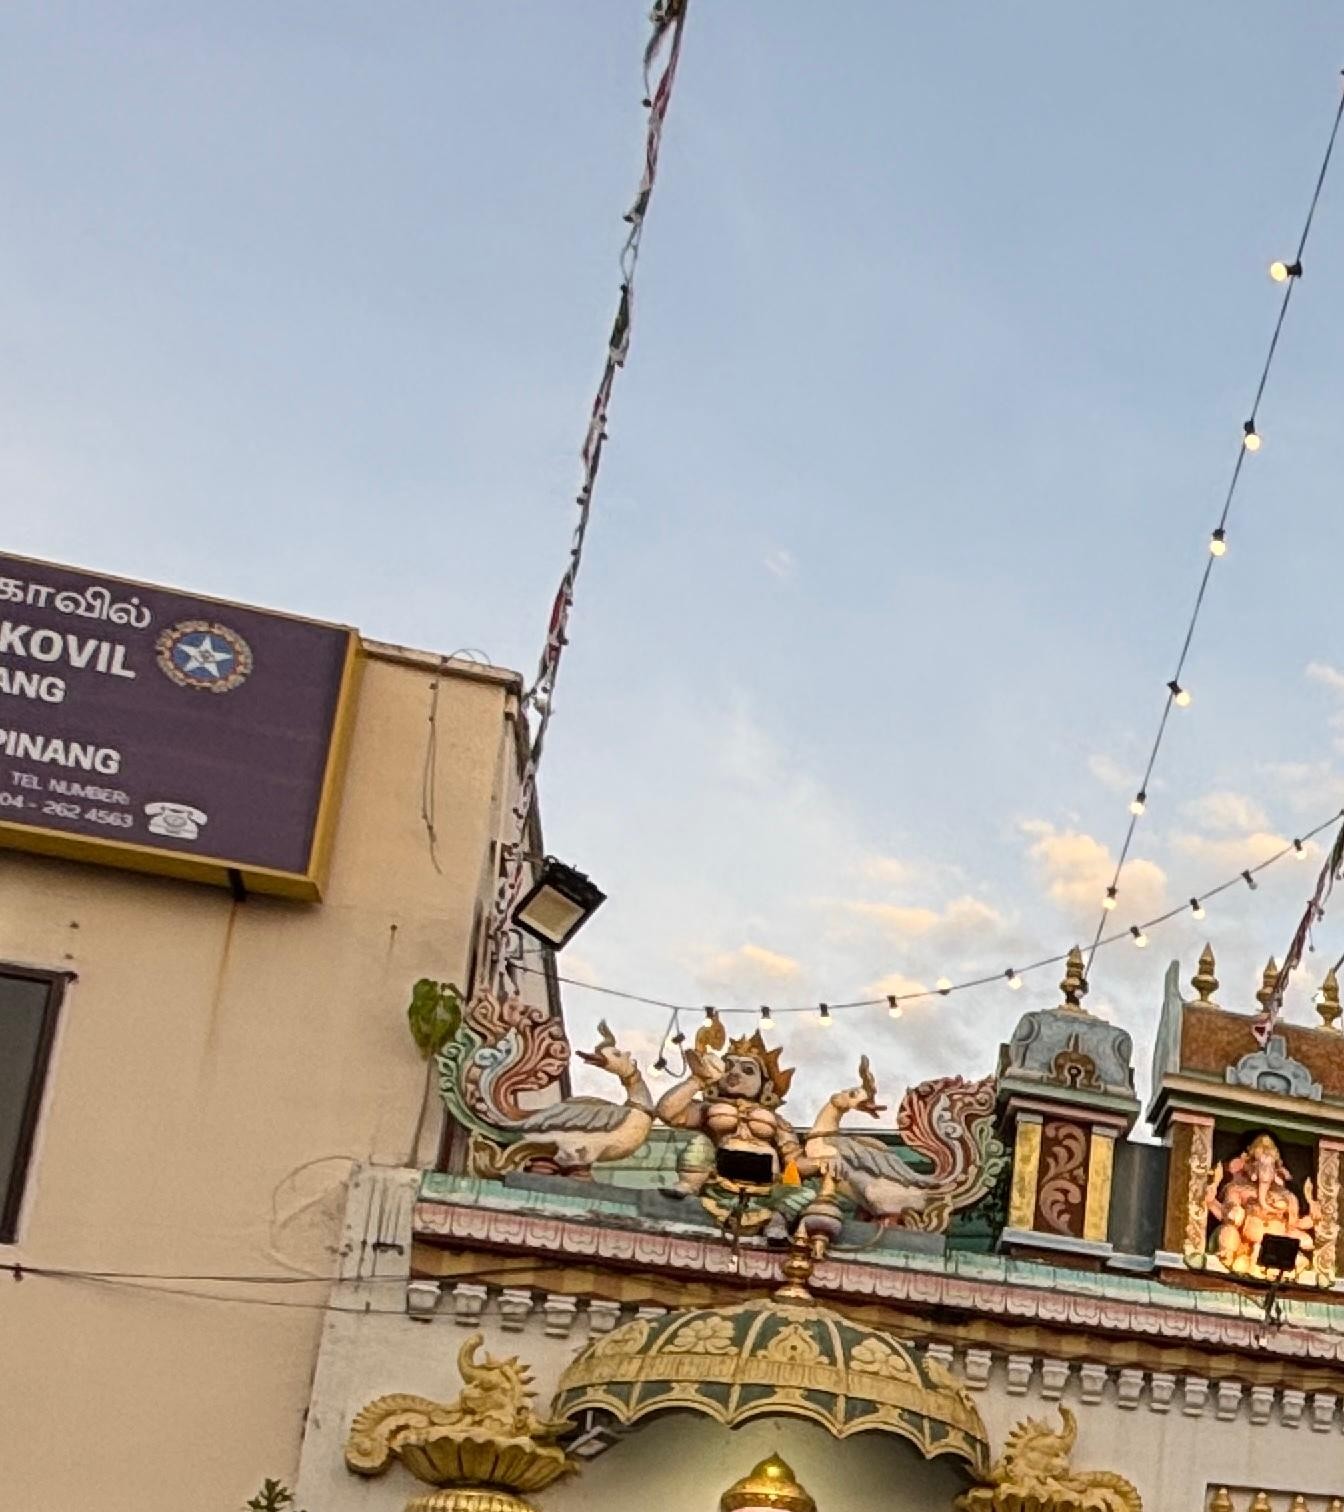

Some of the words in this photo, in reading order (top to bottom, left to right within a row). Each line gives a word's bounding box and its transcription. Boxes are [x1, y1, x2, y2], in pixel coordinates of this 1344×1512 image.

[0, 620, 136, 679] KOVIL
[11, 771, 42, 790] TEL
[42, 800, 81, 819] 262
